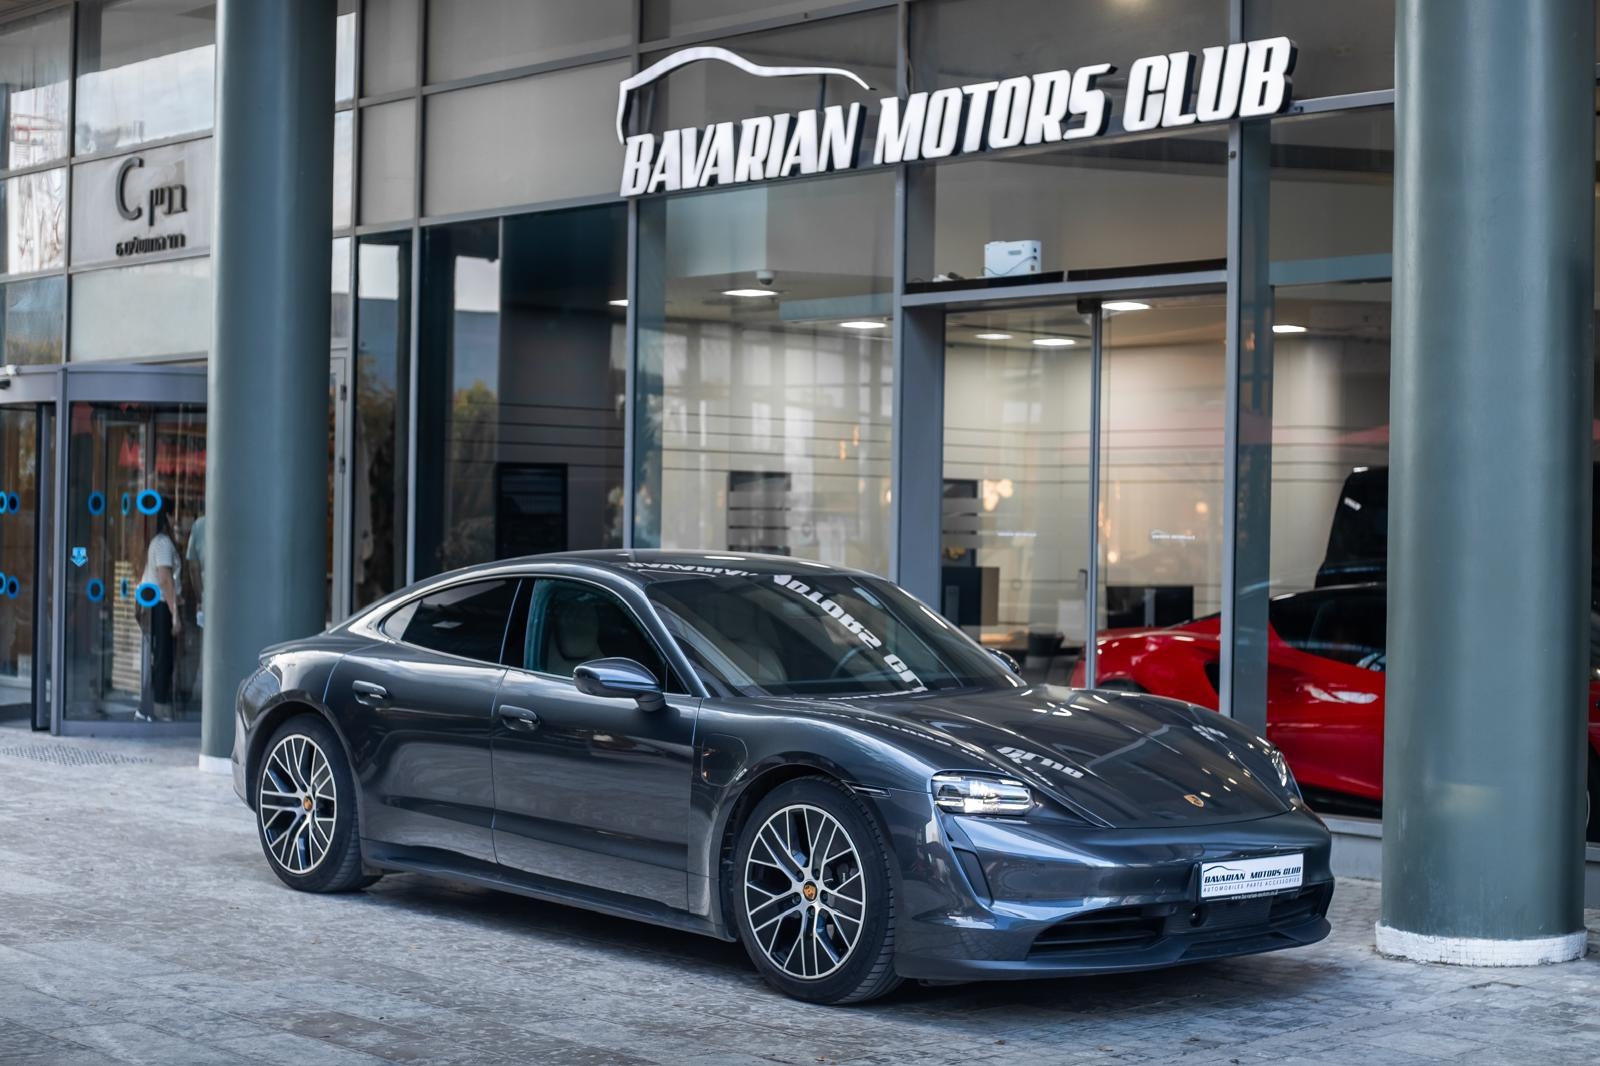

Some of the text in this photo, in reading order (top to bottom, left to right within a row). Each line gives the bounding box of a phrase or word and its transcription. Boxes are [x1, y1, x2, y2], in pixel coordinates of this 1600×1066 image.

[620, 36, 1298, 197] BAVARIAN MOTORS CLUB
[115, 156, 187, 227] בניין C
[1203, 884, 1244, 893] AUTOMOBILES
[1265, 877, 1300, 886] ACCESSORIES
[1204, 866, 1301, 883] BAVARIAN MOTORS CLUB
